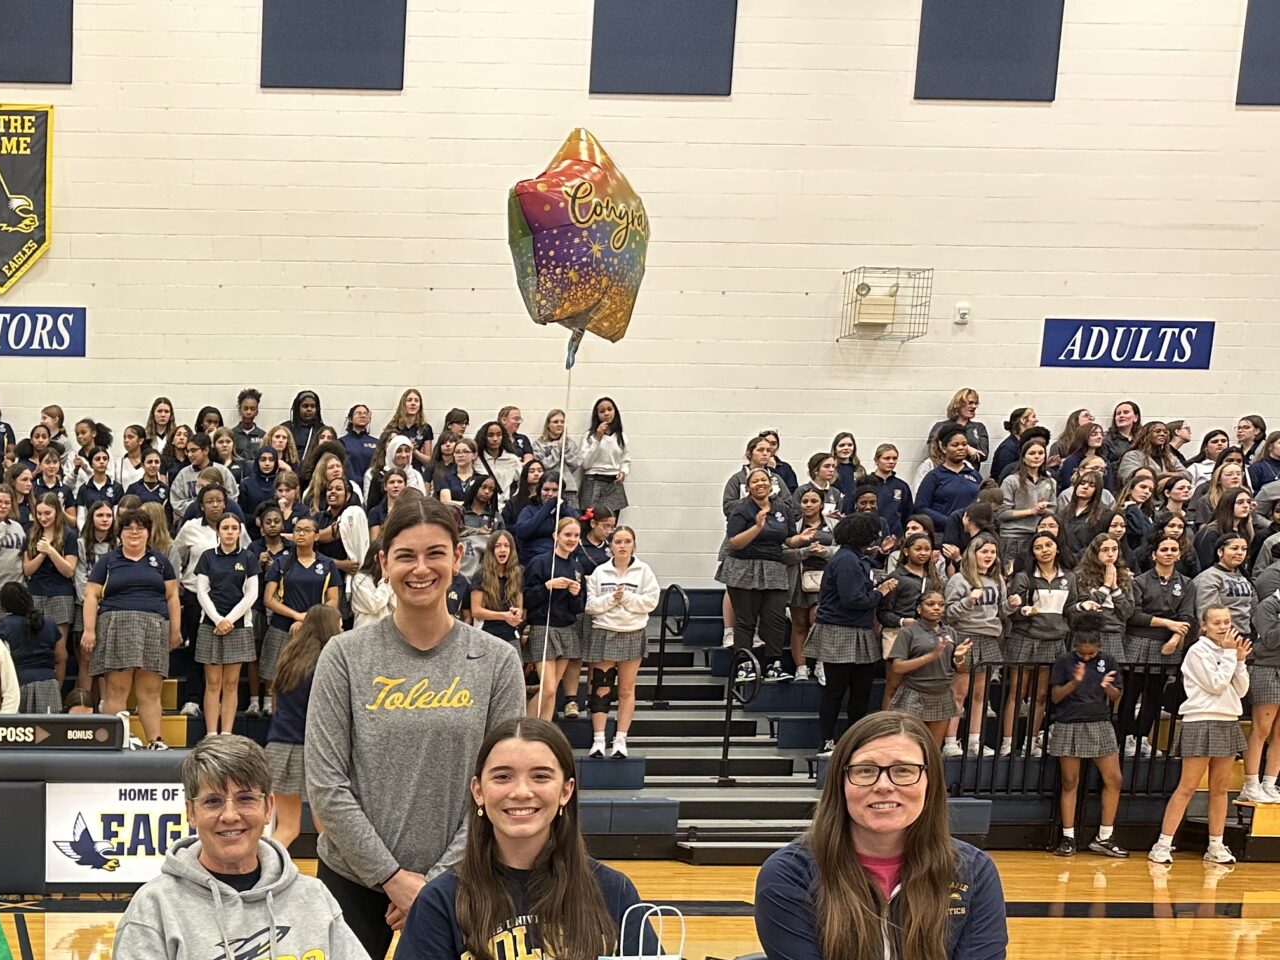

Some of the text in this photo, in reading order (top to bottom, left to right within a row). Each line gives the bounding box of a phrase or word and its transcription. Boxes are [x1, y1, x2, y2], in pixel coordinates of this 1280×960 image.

[564, 180, 646, 251] Congra
[1, 239, 38, 278] EAGLES
[1058, 325, 1198, 363] ADULTS
[365, 676, 474, 710] Toledo
[67, 730, 93, 740] BONUS
[118, 788, 158, 801] HOME
[162, 788, 179, 801] OF
[101, 813, 196, 856] EAG
